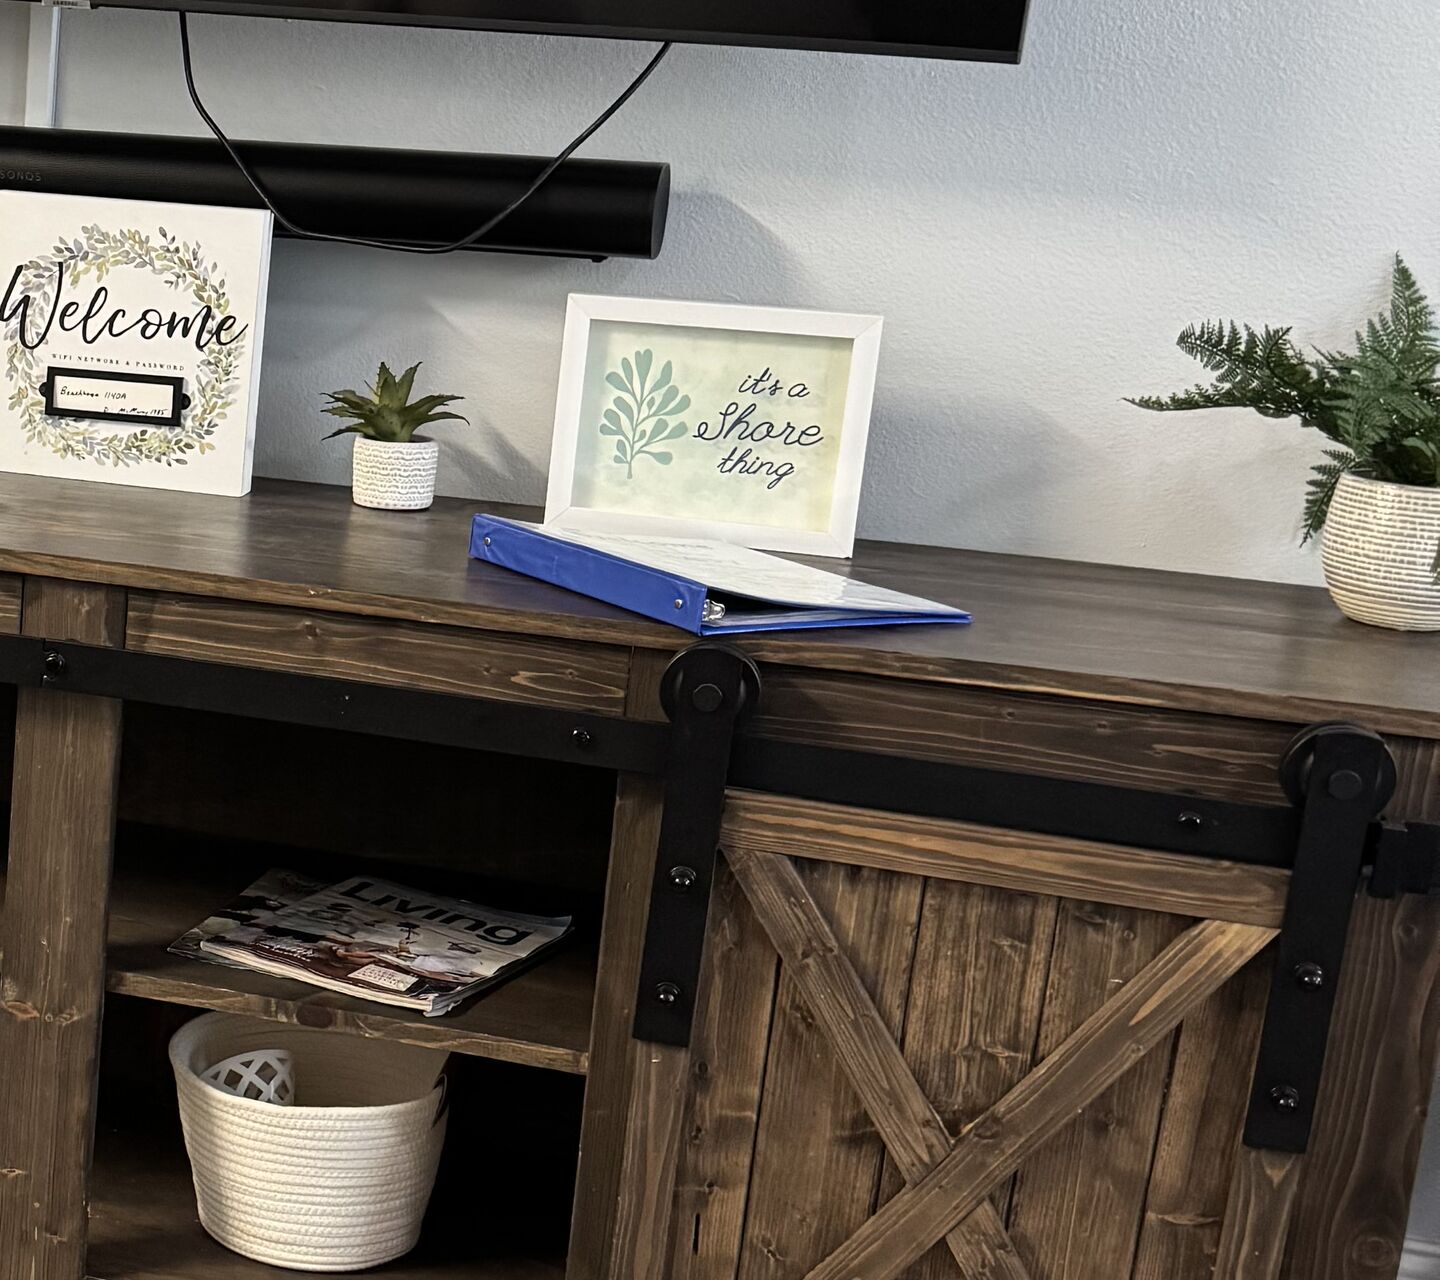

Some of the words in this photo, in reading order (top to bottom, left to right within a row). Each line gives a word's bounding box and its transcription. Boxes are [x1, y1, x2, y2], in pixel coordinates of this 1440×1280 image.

[0, 169, 42, 182] SONOS
[738, 367, 783, 398] it's
[787, 382, 810, 399] a
[692, 402, 824, 447] Shore
[717, 447, 795, 490] thing
[339, 881, 534, 946] Living
